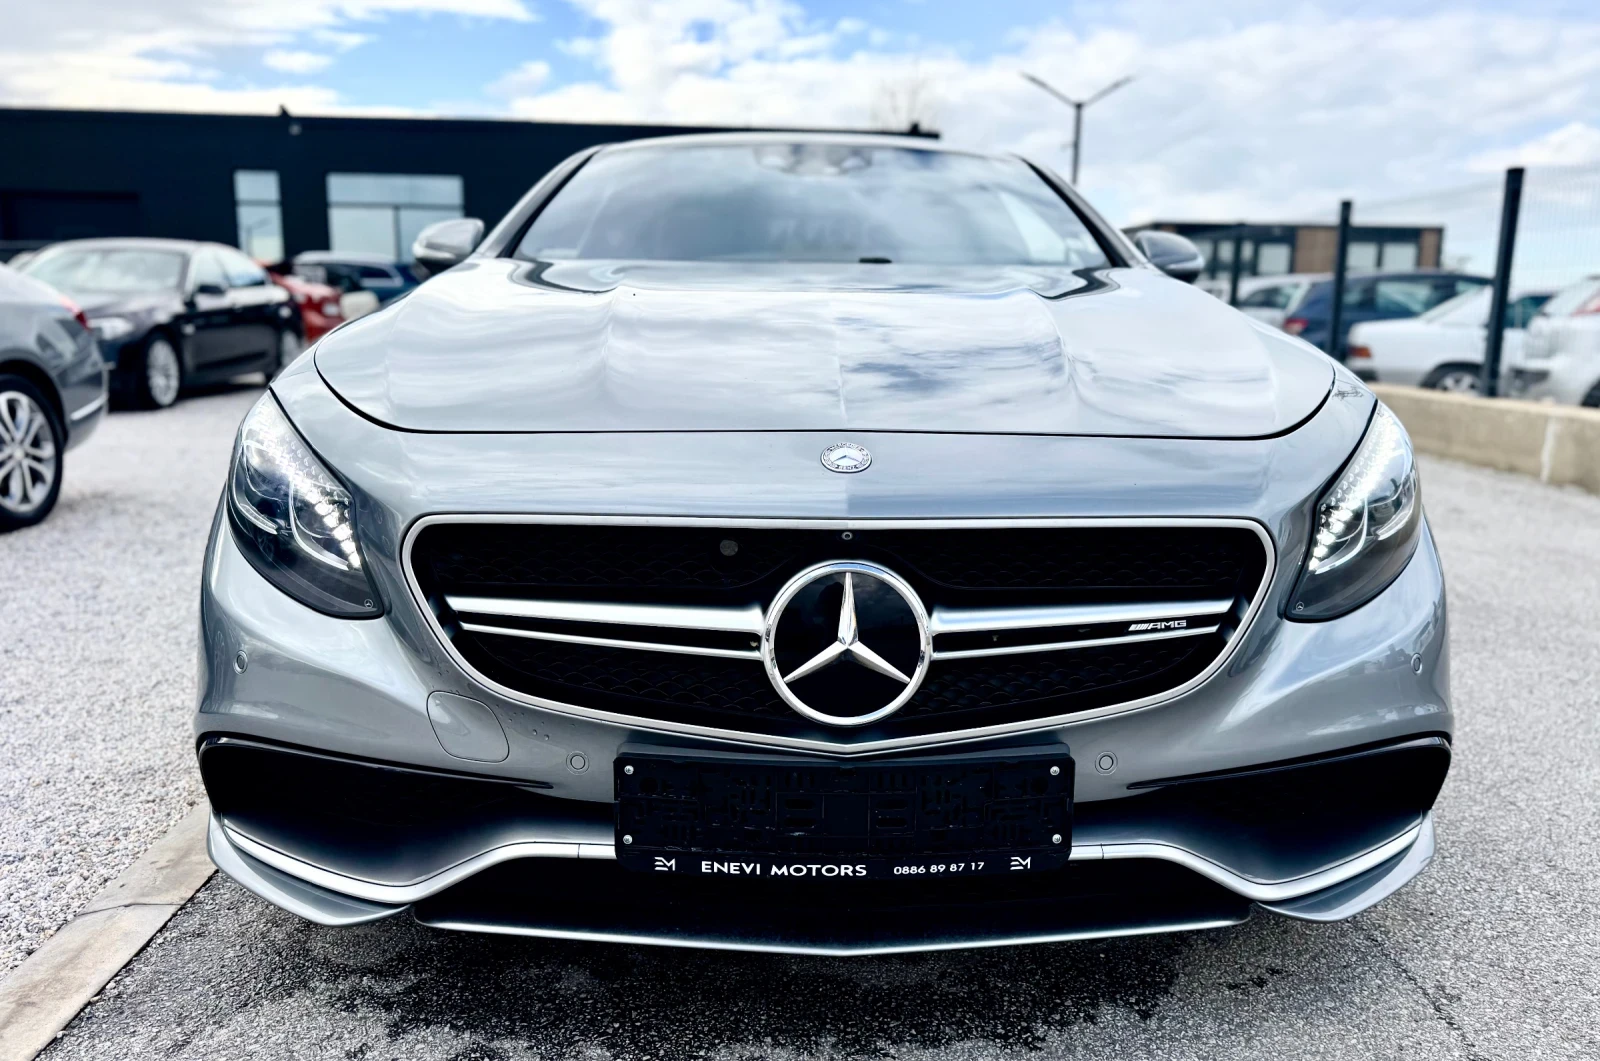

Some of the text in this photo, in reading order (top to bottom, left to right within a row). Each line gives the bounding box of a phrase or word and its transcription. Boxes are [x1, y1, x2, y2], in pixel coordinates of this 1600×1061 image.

[1146, 619, 1187, 630] AMG
[701, 860, 761, 875] ENEVI
[770, 864, 867, 877] MOTORS
[893, 865, 926, 875] 0886
[929, 864, 946, 874] 89
[949, 862, 966, 872] 87
[970, 861, 985, 871] 17
